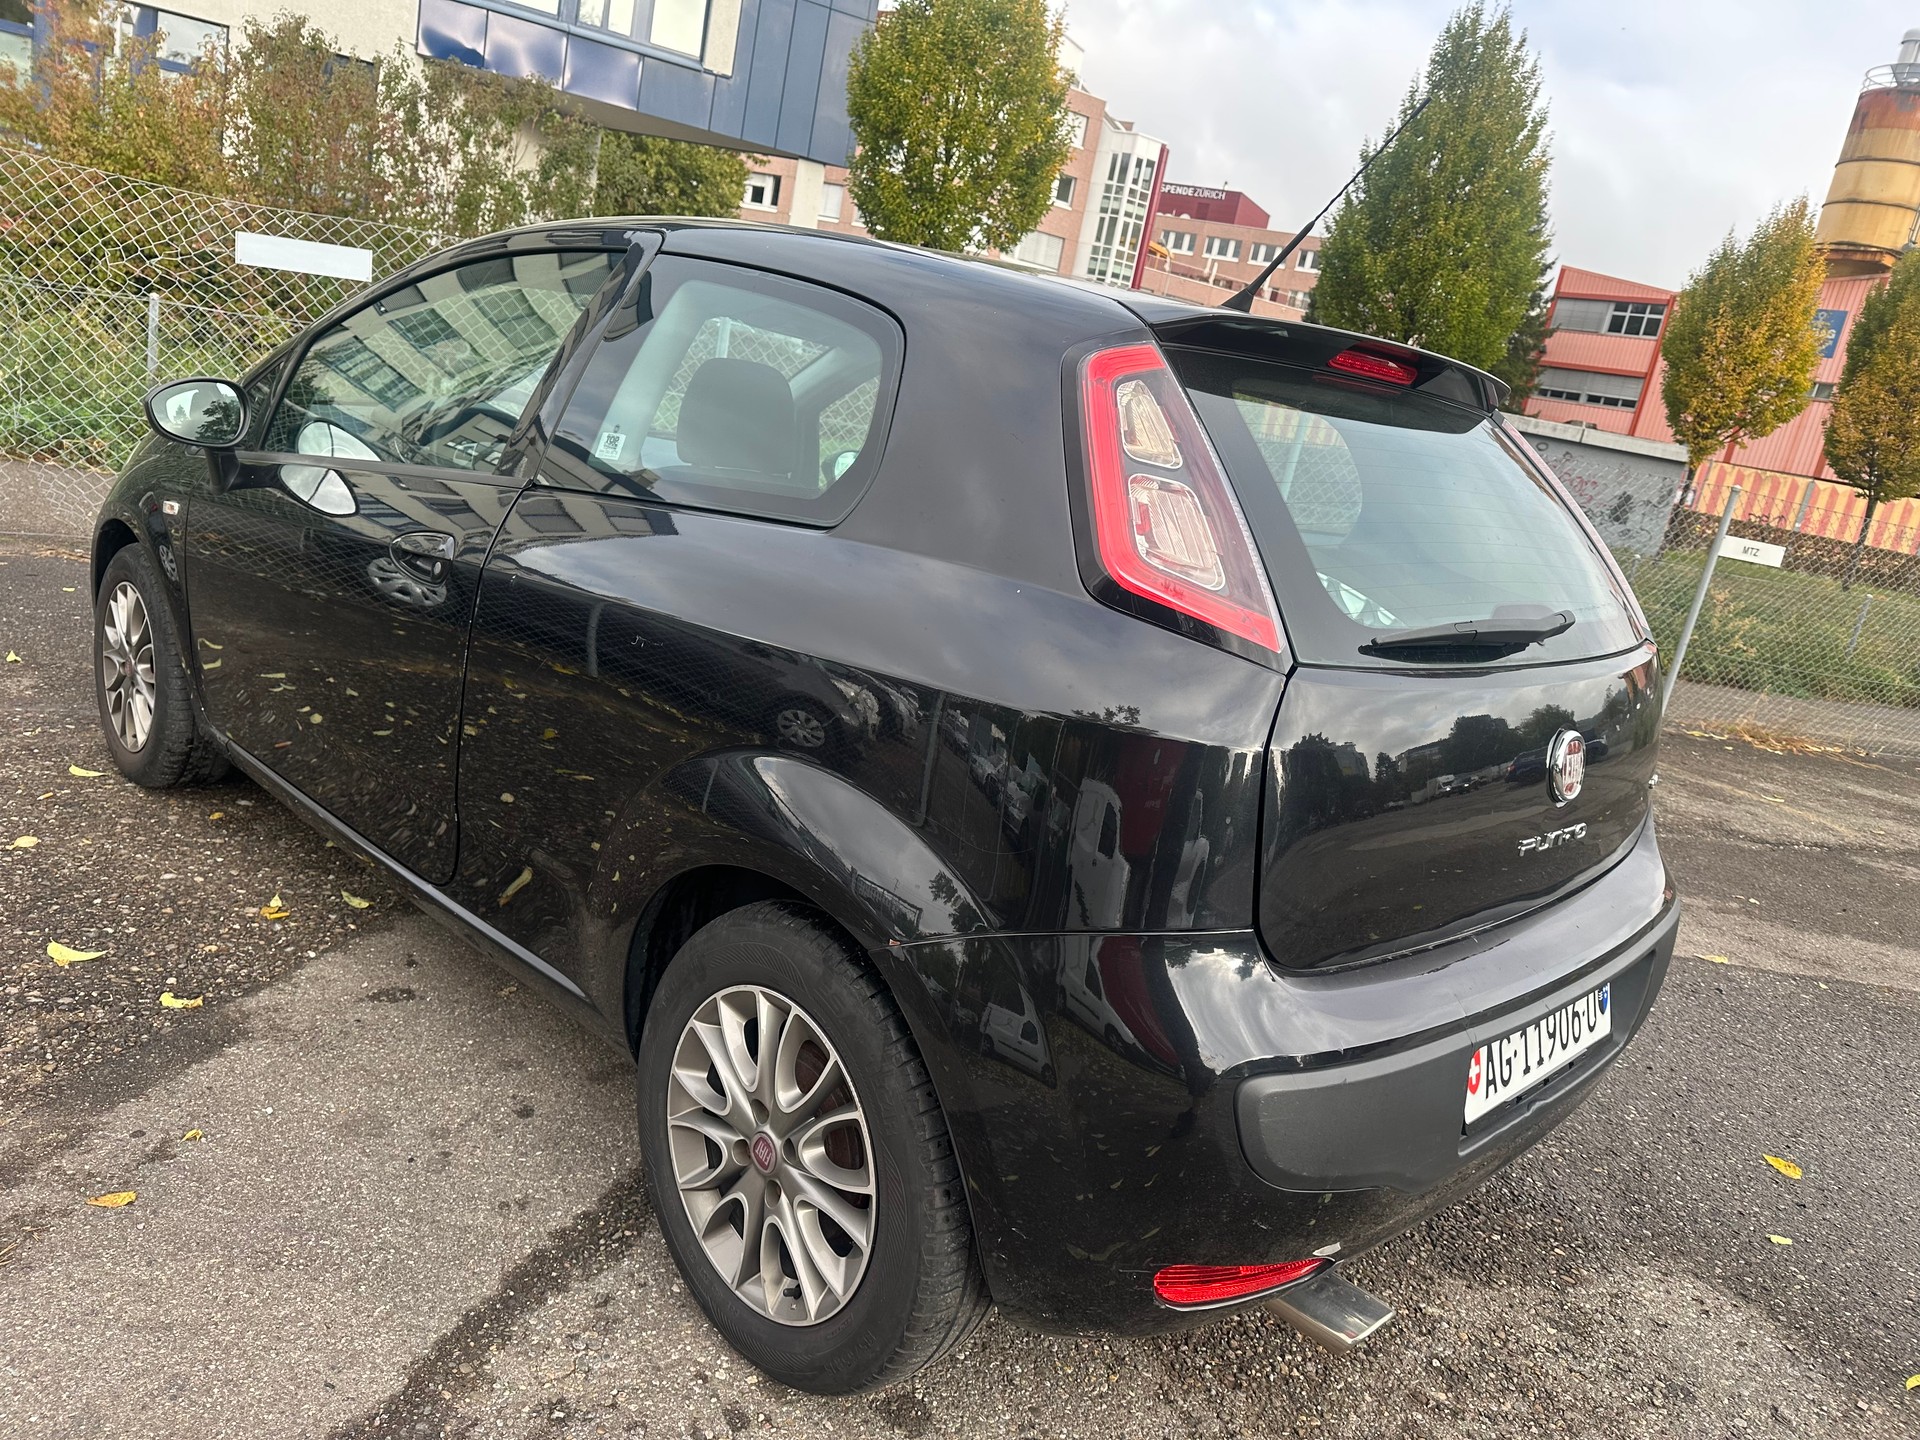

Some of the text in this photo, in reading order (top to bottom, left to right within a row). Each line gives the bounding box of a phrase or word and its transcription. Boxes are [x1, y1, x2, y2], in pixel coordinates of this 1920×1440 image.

[1742, 546, 1760, 557] MTZ
[1518, 822, 1588, 857] PUNTO
[755, 1140, 772, 1166] FIAT
